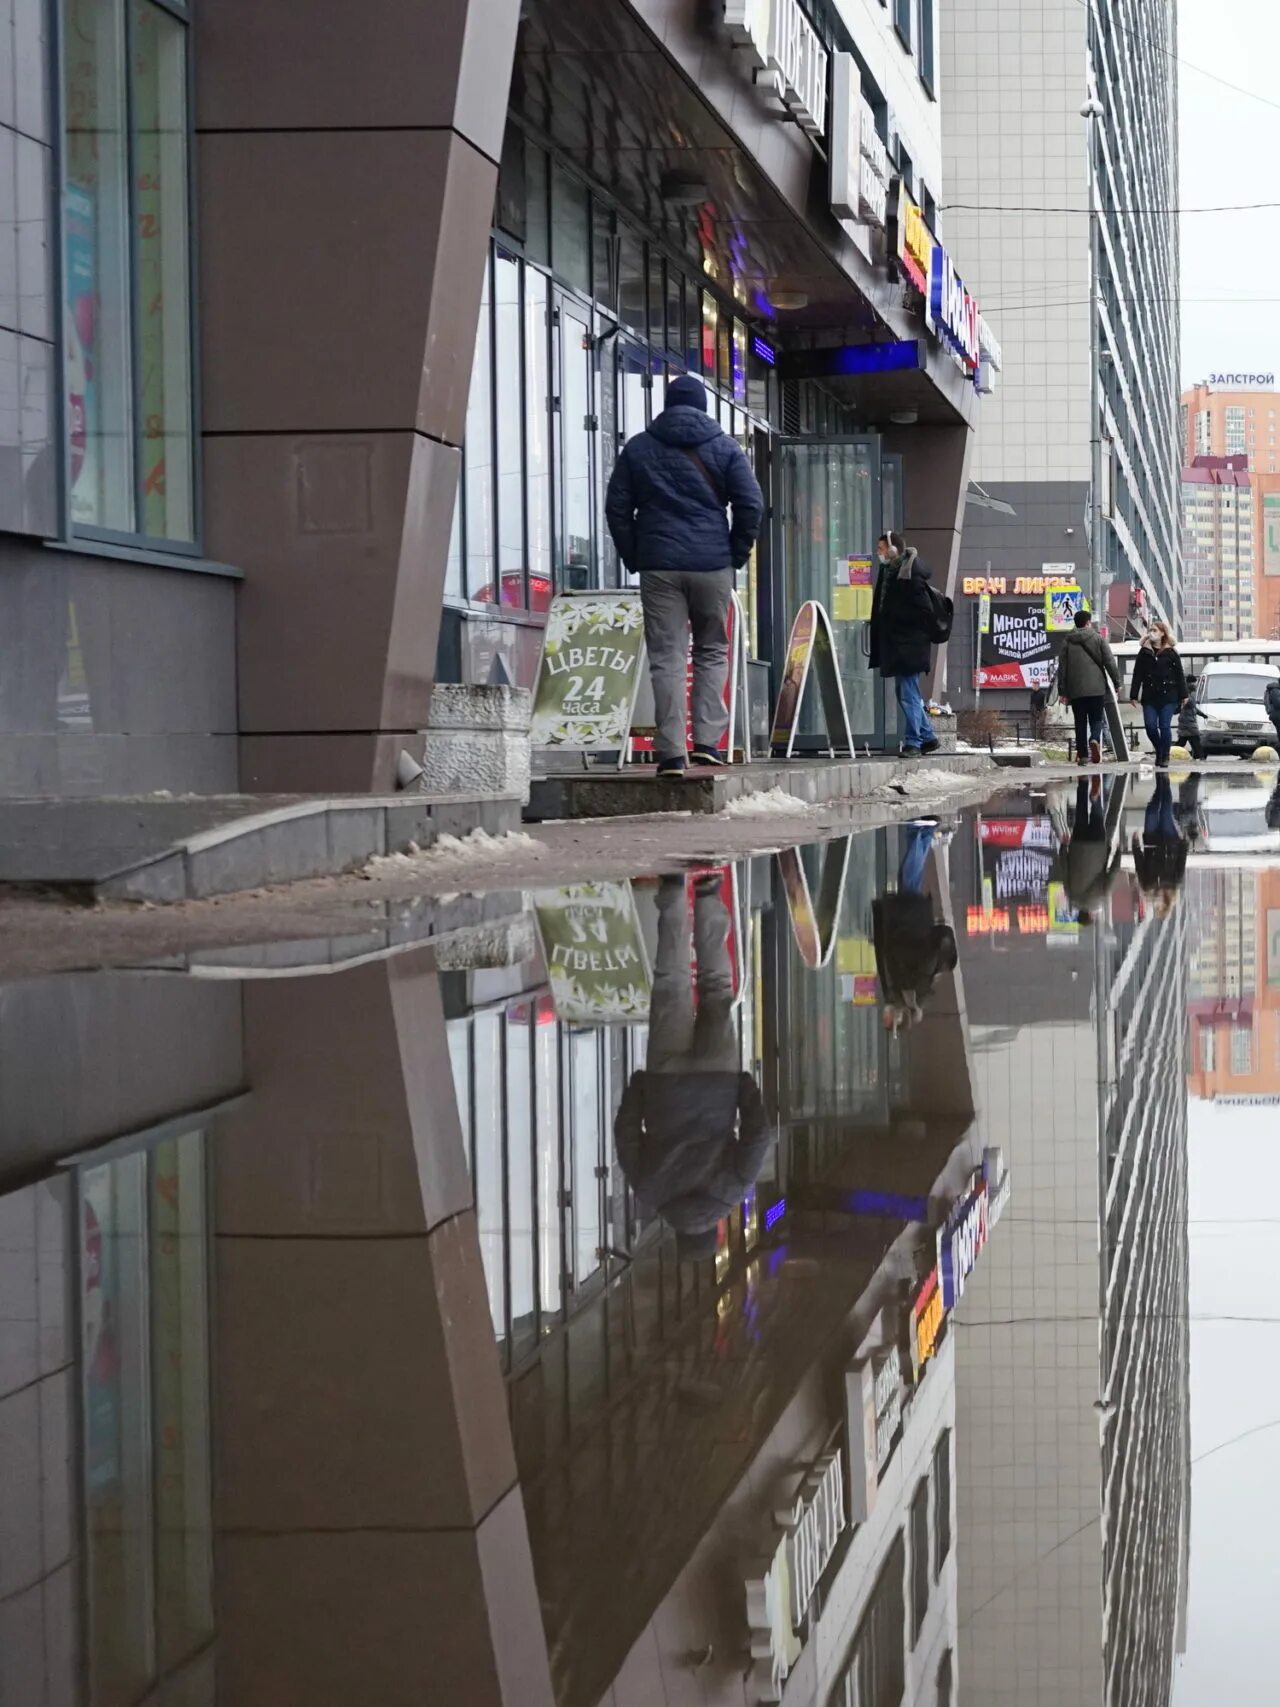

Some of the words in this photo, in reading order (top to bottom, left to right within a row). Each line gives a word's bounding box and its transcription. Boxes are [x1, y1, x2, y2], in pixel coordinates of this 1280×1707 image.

[1210, 372, 1274, 384] ЗАПСТРОЙ
[963, 577, 1007, 594] ВРАЧ
[993, 628, 1048, 651] ГРАННЫЙ
[545, 646, 635, 676] ЦВЕТЫ
[990, 674, 1019, 682] МАВИС
[1029, 667, 1040, 677] 10
[563, 675, 606, 701] 24
[562, 701, 601, 715] часа
